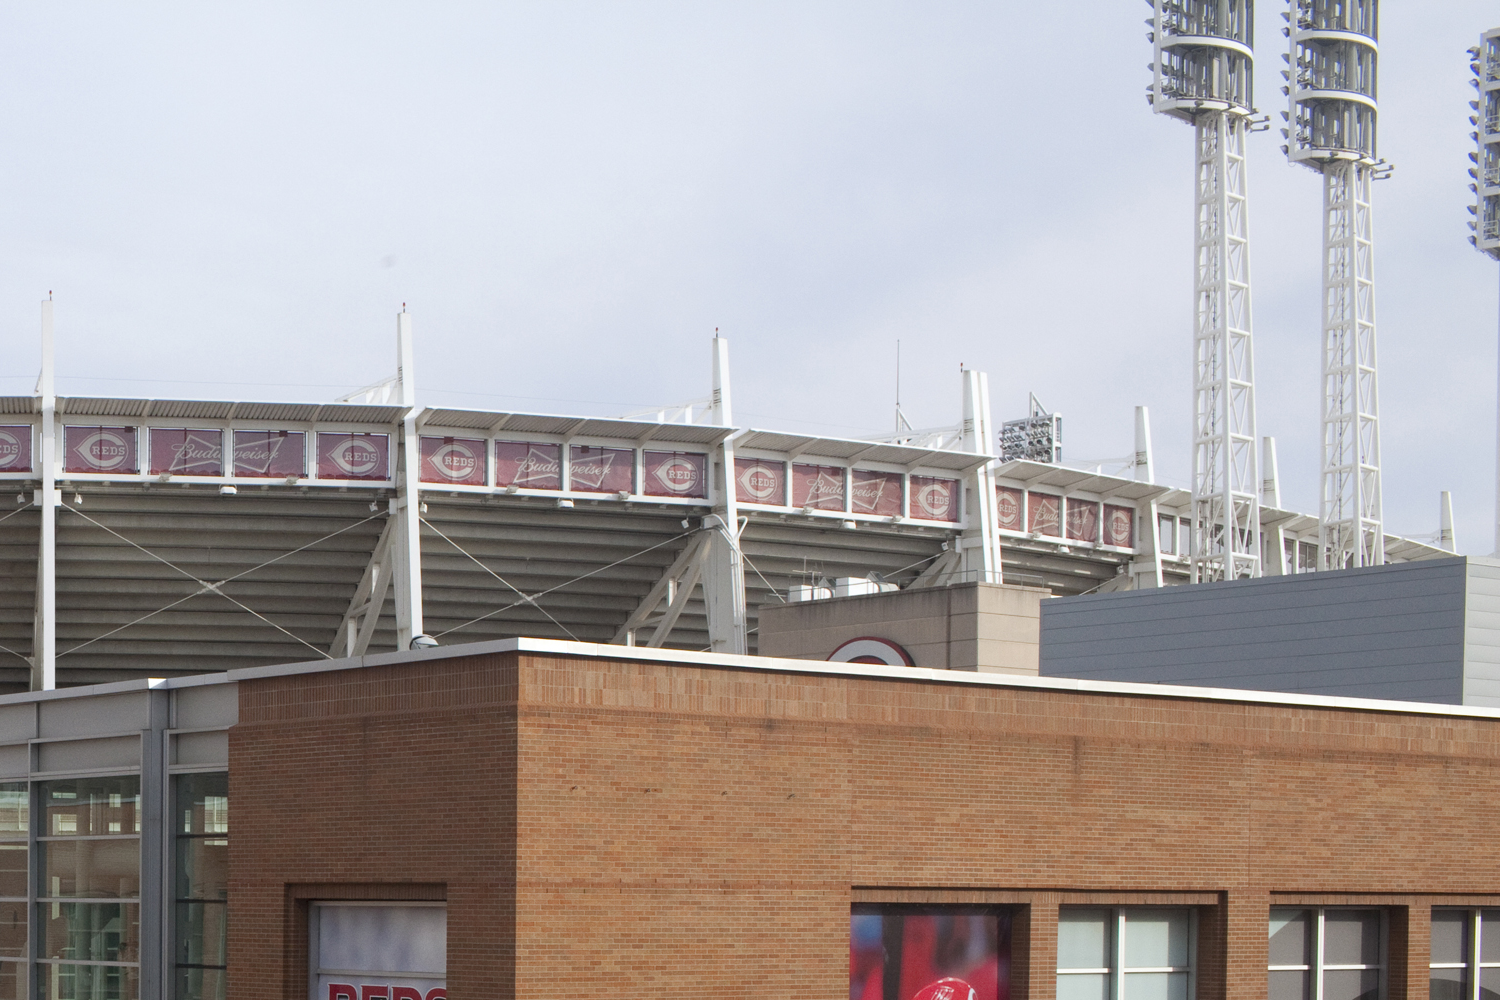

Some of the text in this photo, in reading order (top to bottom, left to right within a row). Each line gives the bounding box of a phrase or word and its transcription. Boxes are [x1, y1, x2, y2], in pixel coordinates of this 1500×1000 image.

[91, 446, 125, 456] REDS
[344, 452, 377, 462] REDS
[444, 456, 474, 467] REDS
[668, 470, 696, 480] REDS
[750, 477, 775, 487] REDS
[927, 495, 949, 505] REDS
[999, 504, 1016, 514] REDS
